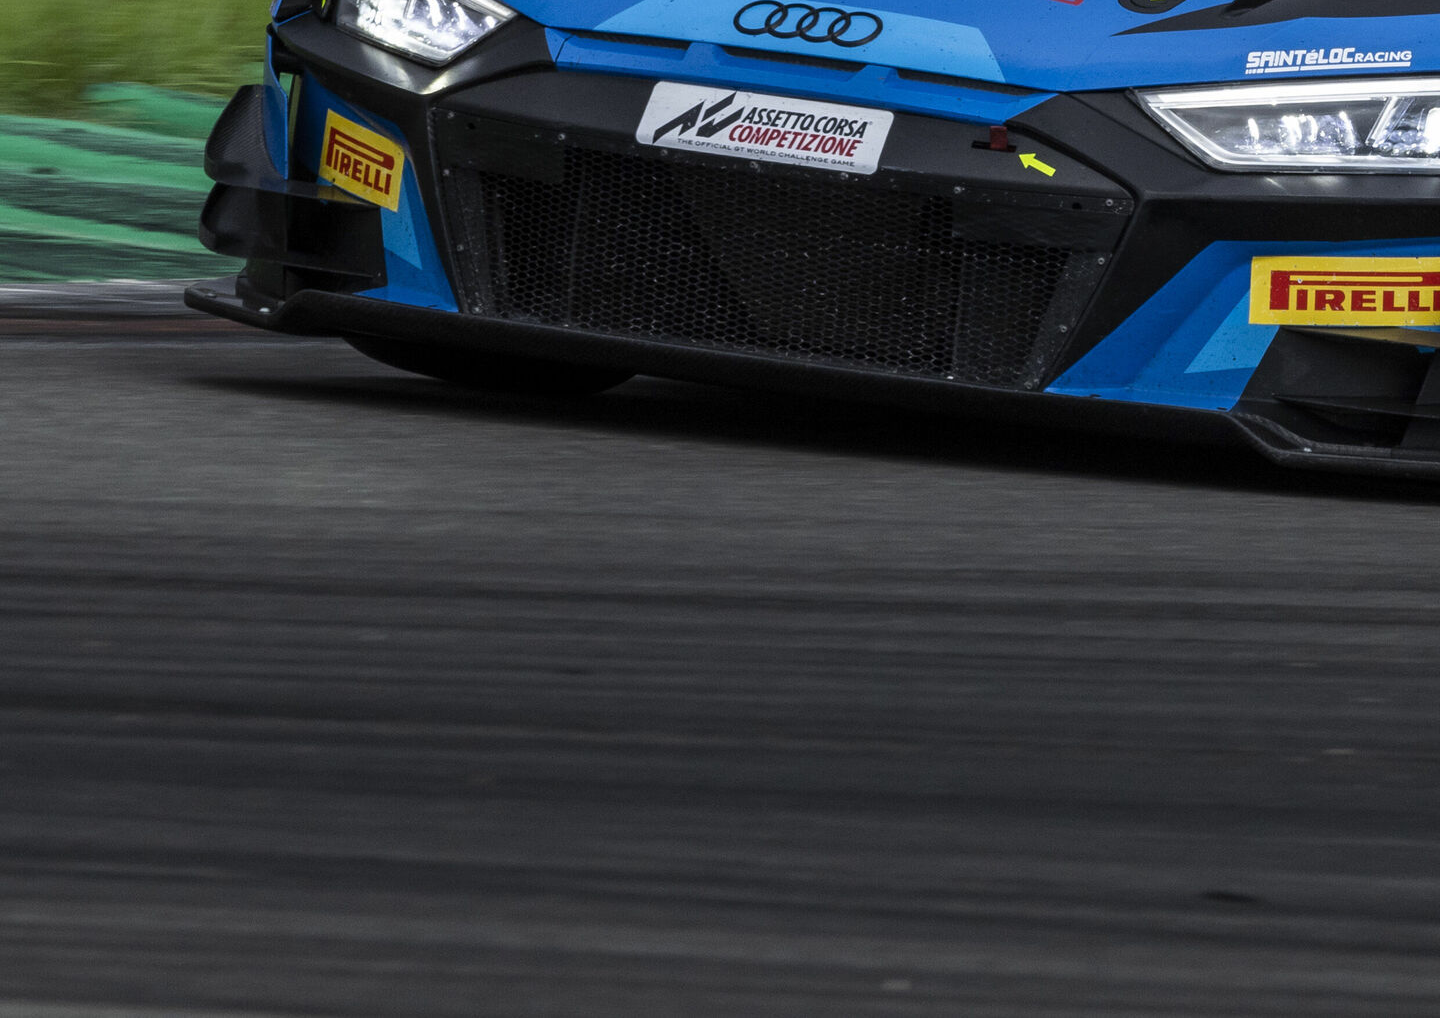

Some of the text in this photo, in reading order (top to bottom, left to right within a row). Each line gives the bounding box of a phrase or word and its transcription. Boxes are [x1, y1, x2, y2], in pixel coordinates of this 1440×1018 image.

[742, 107, 815, 131] ASSETTO
[677, 138, 694, 146] THE
[695, 140, 732, 151] OFFICIAL
[746, 146, 776, 156] WORLD
[778, 150, 829, 163] CHALLENGE
[831, 158, 856, 167] GAME
[729, 125, 863, 157] COMPETIZIONE
[326, 126, 395, 195] PIRELLI
